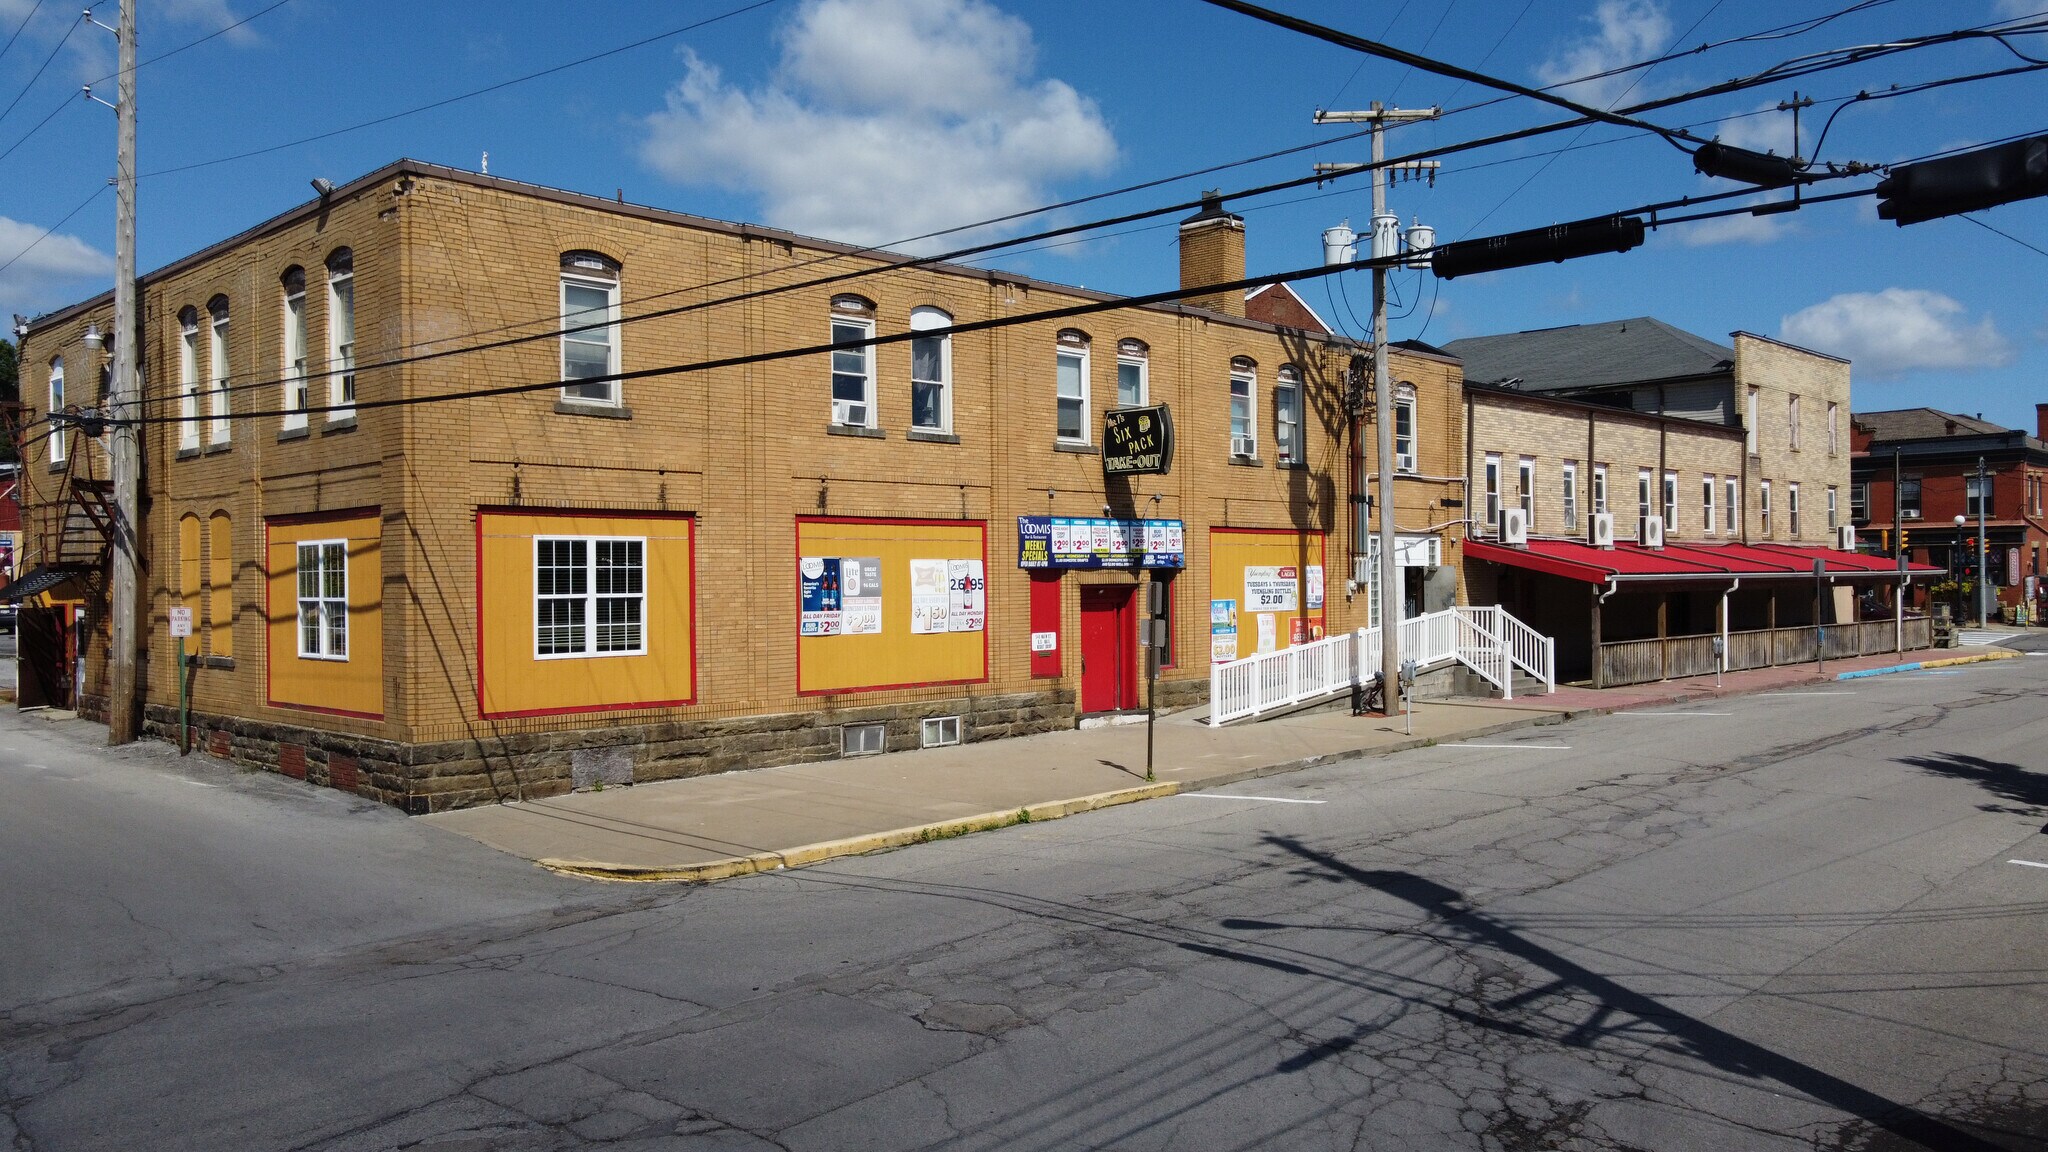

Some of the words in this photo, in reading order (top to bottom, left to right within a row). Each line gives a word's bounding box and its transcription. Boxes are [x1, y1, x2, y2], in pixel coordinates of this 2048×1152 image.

[1113, 426, 1132, 444] SIX
[1128, 433, 1154, 455] PACK
[1106, 453, 1161, 470] TAKE-OUT
[1020, 524, 1051, 535] LOOMIS
[1025, 540, 1047, 551] WEEKLY
[1021, 551, 1048, 561] SPECIALS
[802, 561, 824, 570] LOOMIS
[846, 568, 858, 578] Lite
[971, 578, 983, 590] 95
[1261, 595, 1283, 605] $2.00
